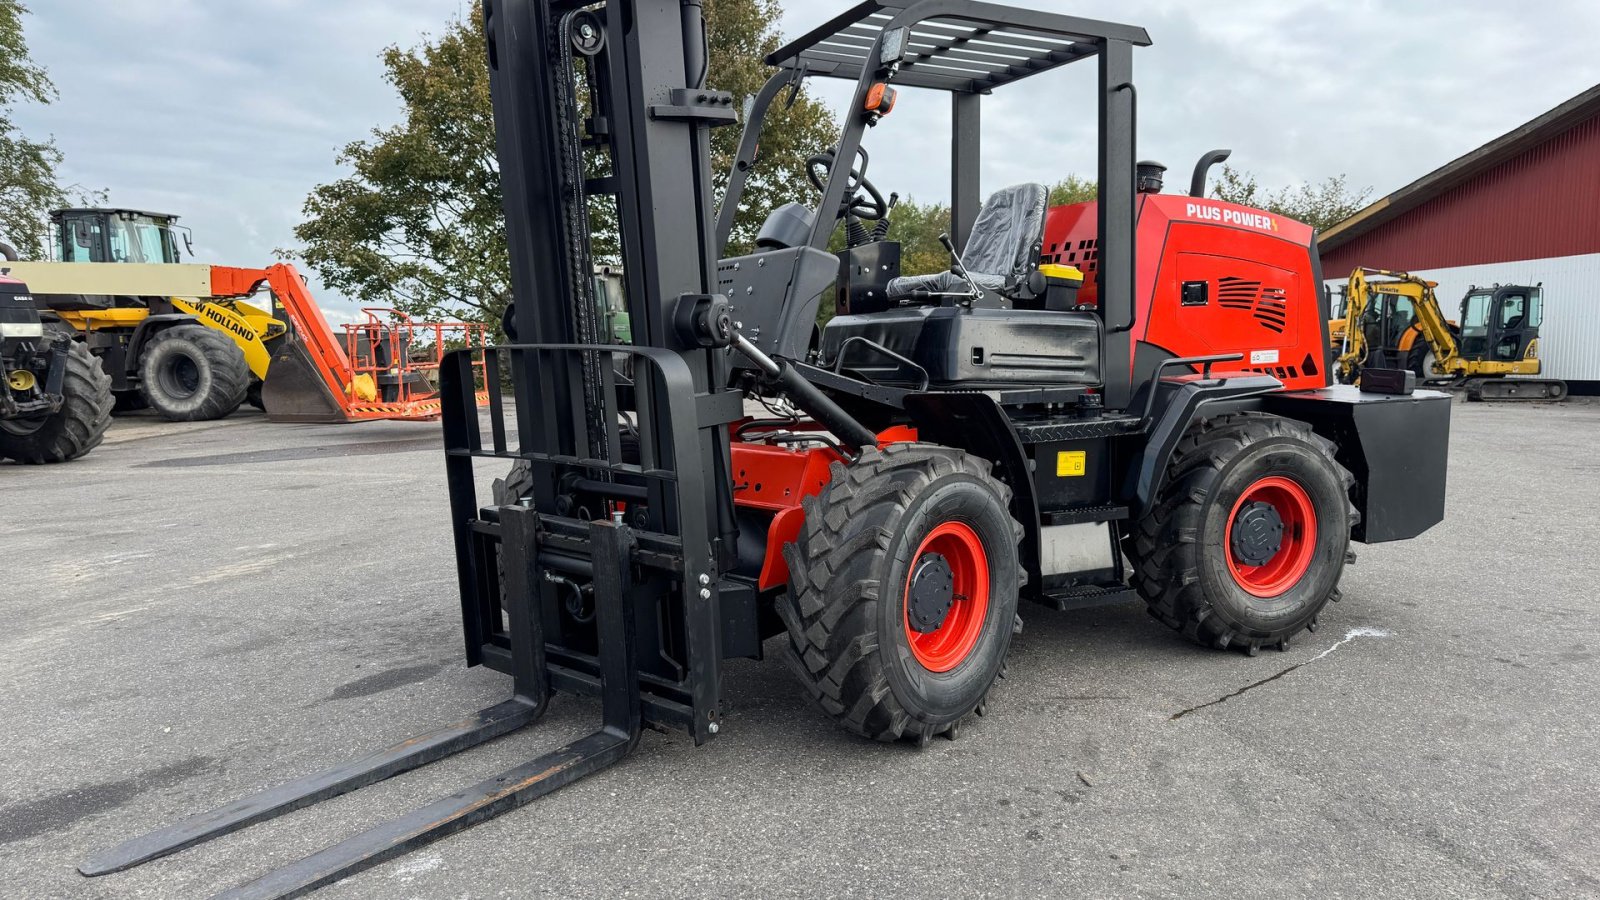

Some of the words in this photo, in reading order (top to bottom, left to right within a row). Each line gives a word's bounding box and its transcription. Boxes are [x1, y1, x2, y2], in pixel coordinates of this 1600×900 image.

[1186, 203, 1221, 221] PLUS
[1223, 209, 1271, 230] POWER
[206, 308, 254, 342] HOLLAND
